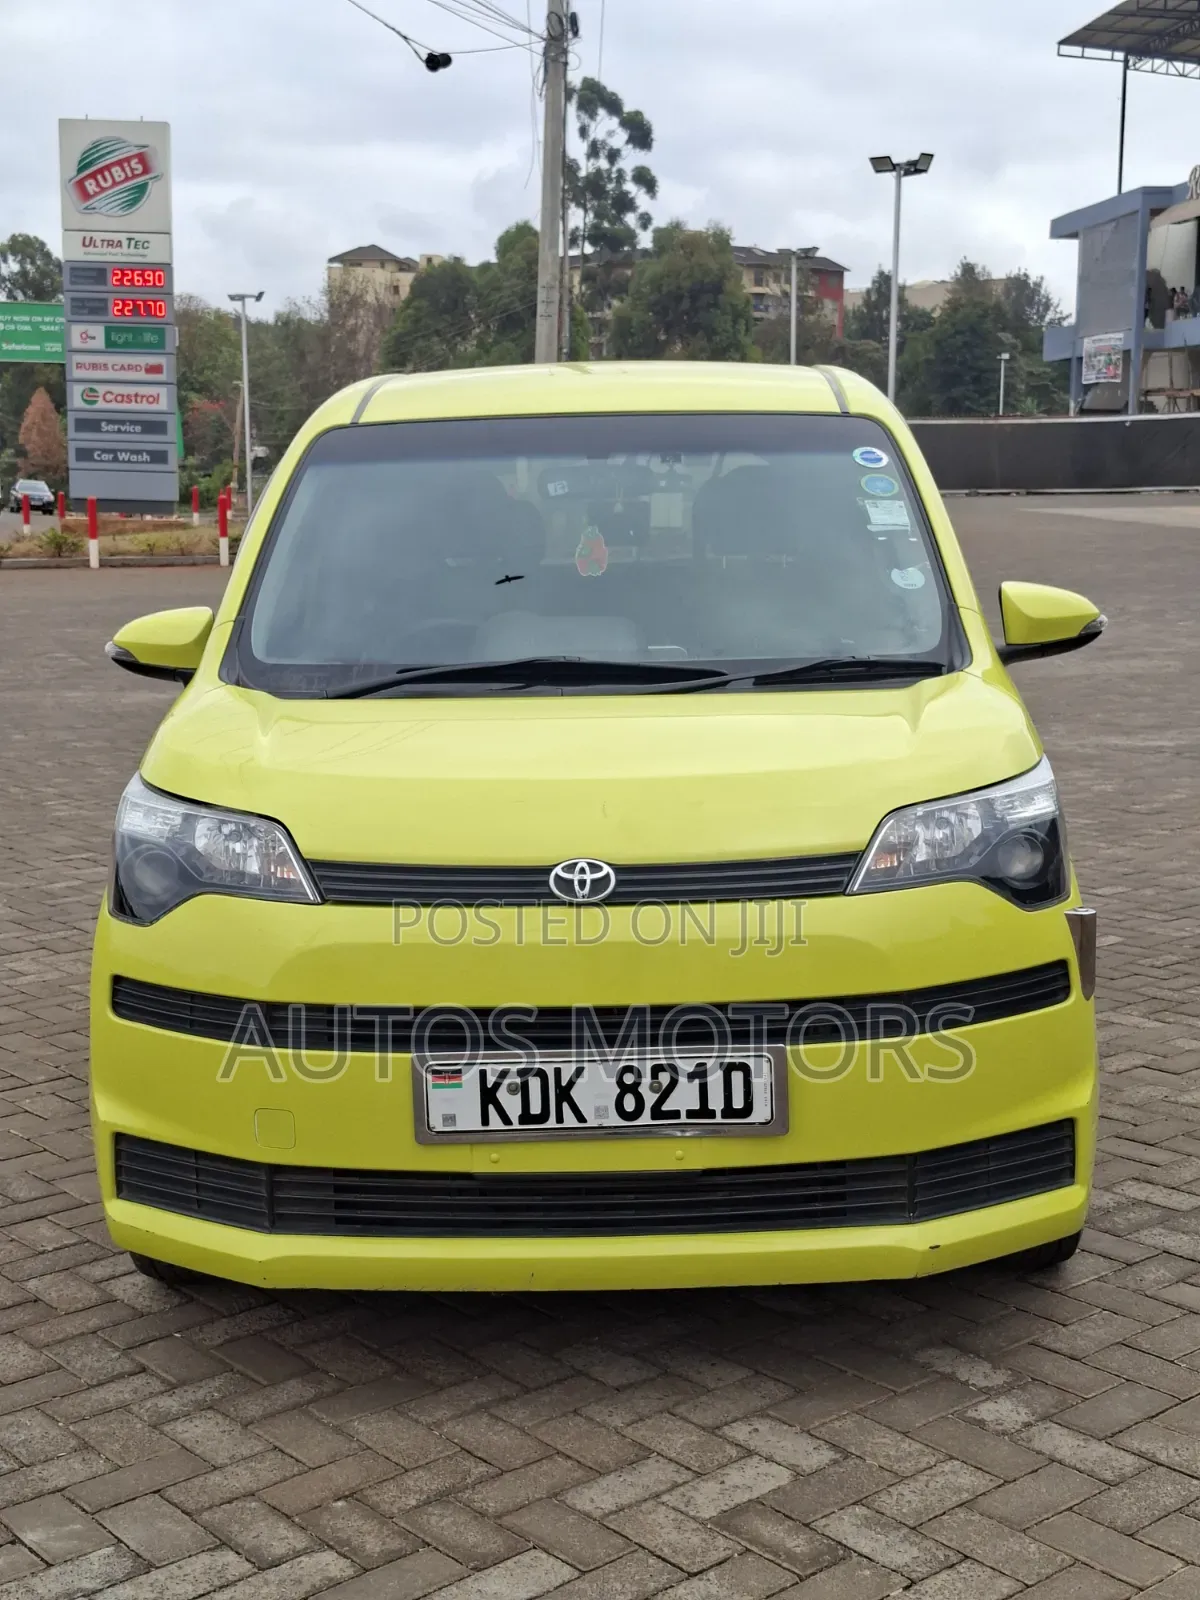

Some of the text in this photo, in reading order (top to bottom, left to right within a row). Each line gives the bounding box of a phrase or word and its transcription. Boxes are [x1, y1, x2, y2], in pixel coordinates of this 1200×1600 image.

[111, 363, 143, 373] CARD
[102, 390, 160, 405] Castrol
[100, 421, 142, 433] Service
[93, 451, 150, 462] Car Wash
[478, 1066, 588, 1126] KDK
[614, 1061, 754, 1122] 821D
